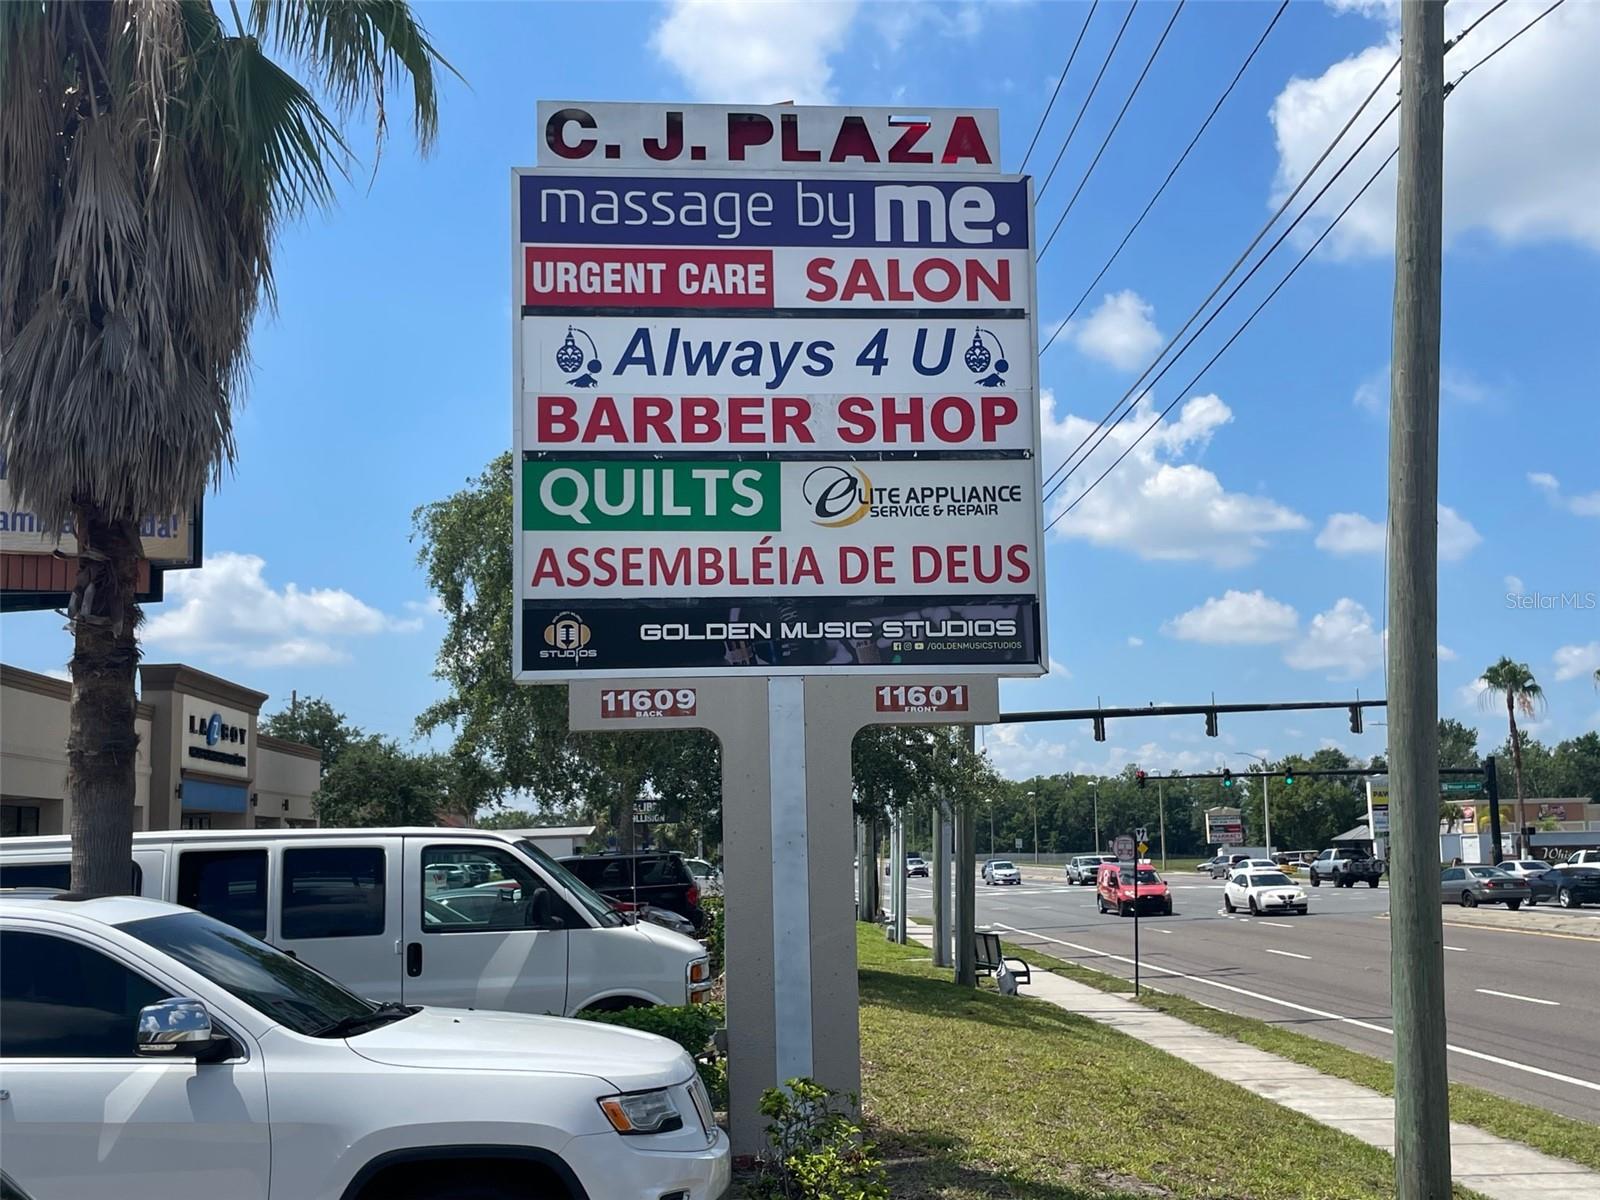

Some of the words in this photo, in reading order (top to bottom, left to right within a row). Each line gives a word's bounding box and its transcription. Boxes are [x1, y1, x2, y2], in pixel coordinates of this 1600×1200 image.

[545, 108, 620, 160] C.
[643, 111, 706, 161] J.
[727, 112, 992, 164] PLAZA
[540, 187, 774, 239] massage
[797, 181, 854, 239] by
[874, 185, 1011, 243] me.
[533, 262, 667, 294] URGENT
[678, 263, 766, 295] CARE
[805, 257, 1011, 302] SALON
[613, 328, 836, 389] Always
[856, 328, 889, 376] 4
[912, 328, 956, 376] U
[537, 396, 815, 443] BARBER
[837, 396, 1018, 443] SHOP
[540, 467, 764, 524] QUILTS
[870, 504, 930, 518] SERVICE
[933, 504, 943, 516] &
[947, 504, 998, 516] REPAIR
[905, 485, 1022, 503] APPLIANCE
[531, 536, 824, 587] ASSEMBLÉIA
[840, 545, 895, 586] DE
[912, 544, 1031, 585] DEUS
[640, 623, 771, 641] GOLDEN
[781, 621, 872, 639] MUSIC
[882, 620, 1017, 638] STUDIOS
[540, 649, 598, 658] STUDIOS
[602, 690, 696, 711] 11609
[879, 686, 963, 705] 11601
